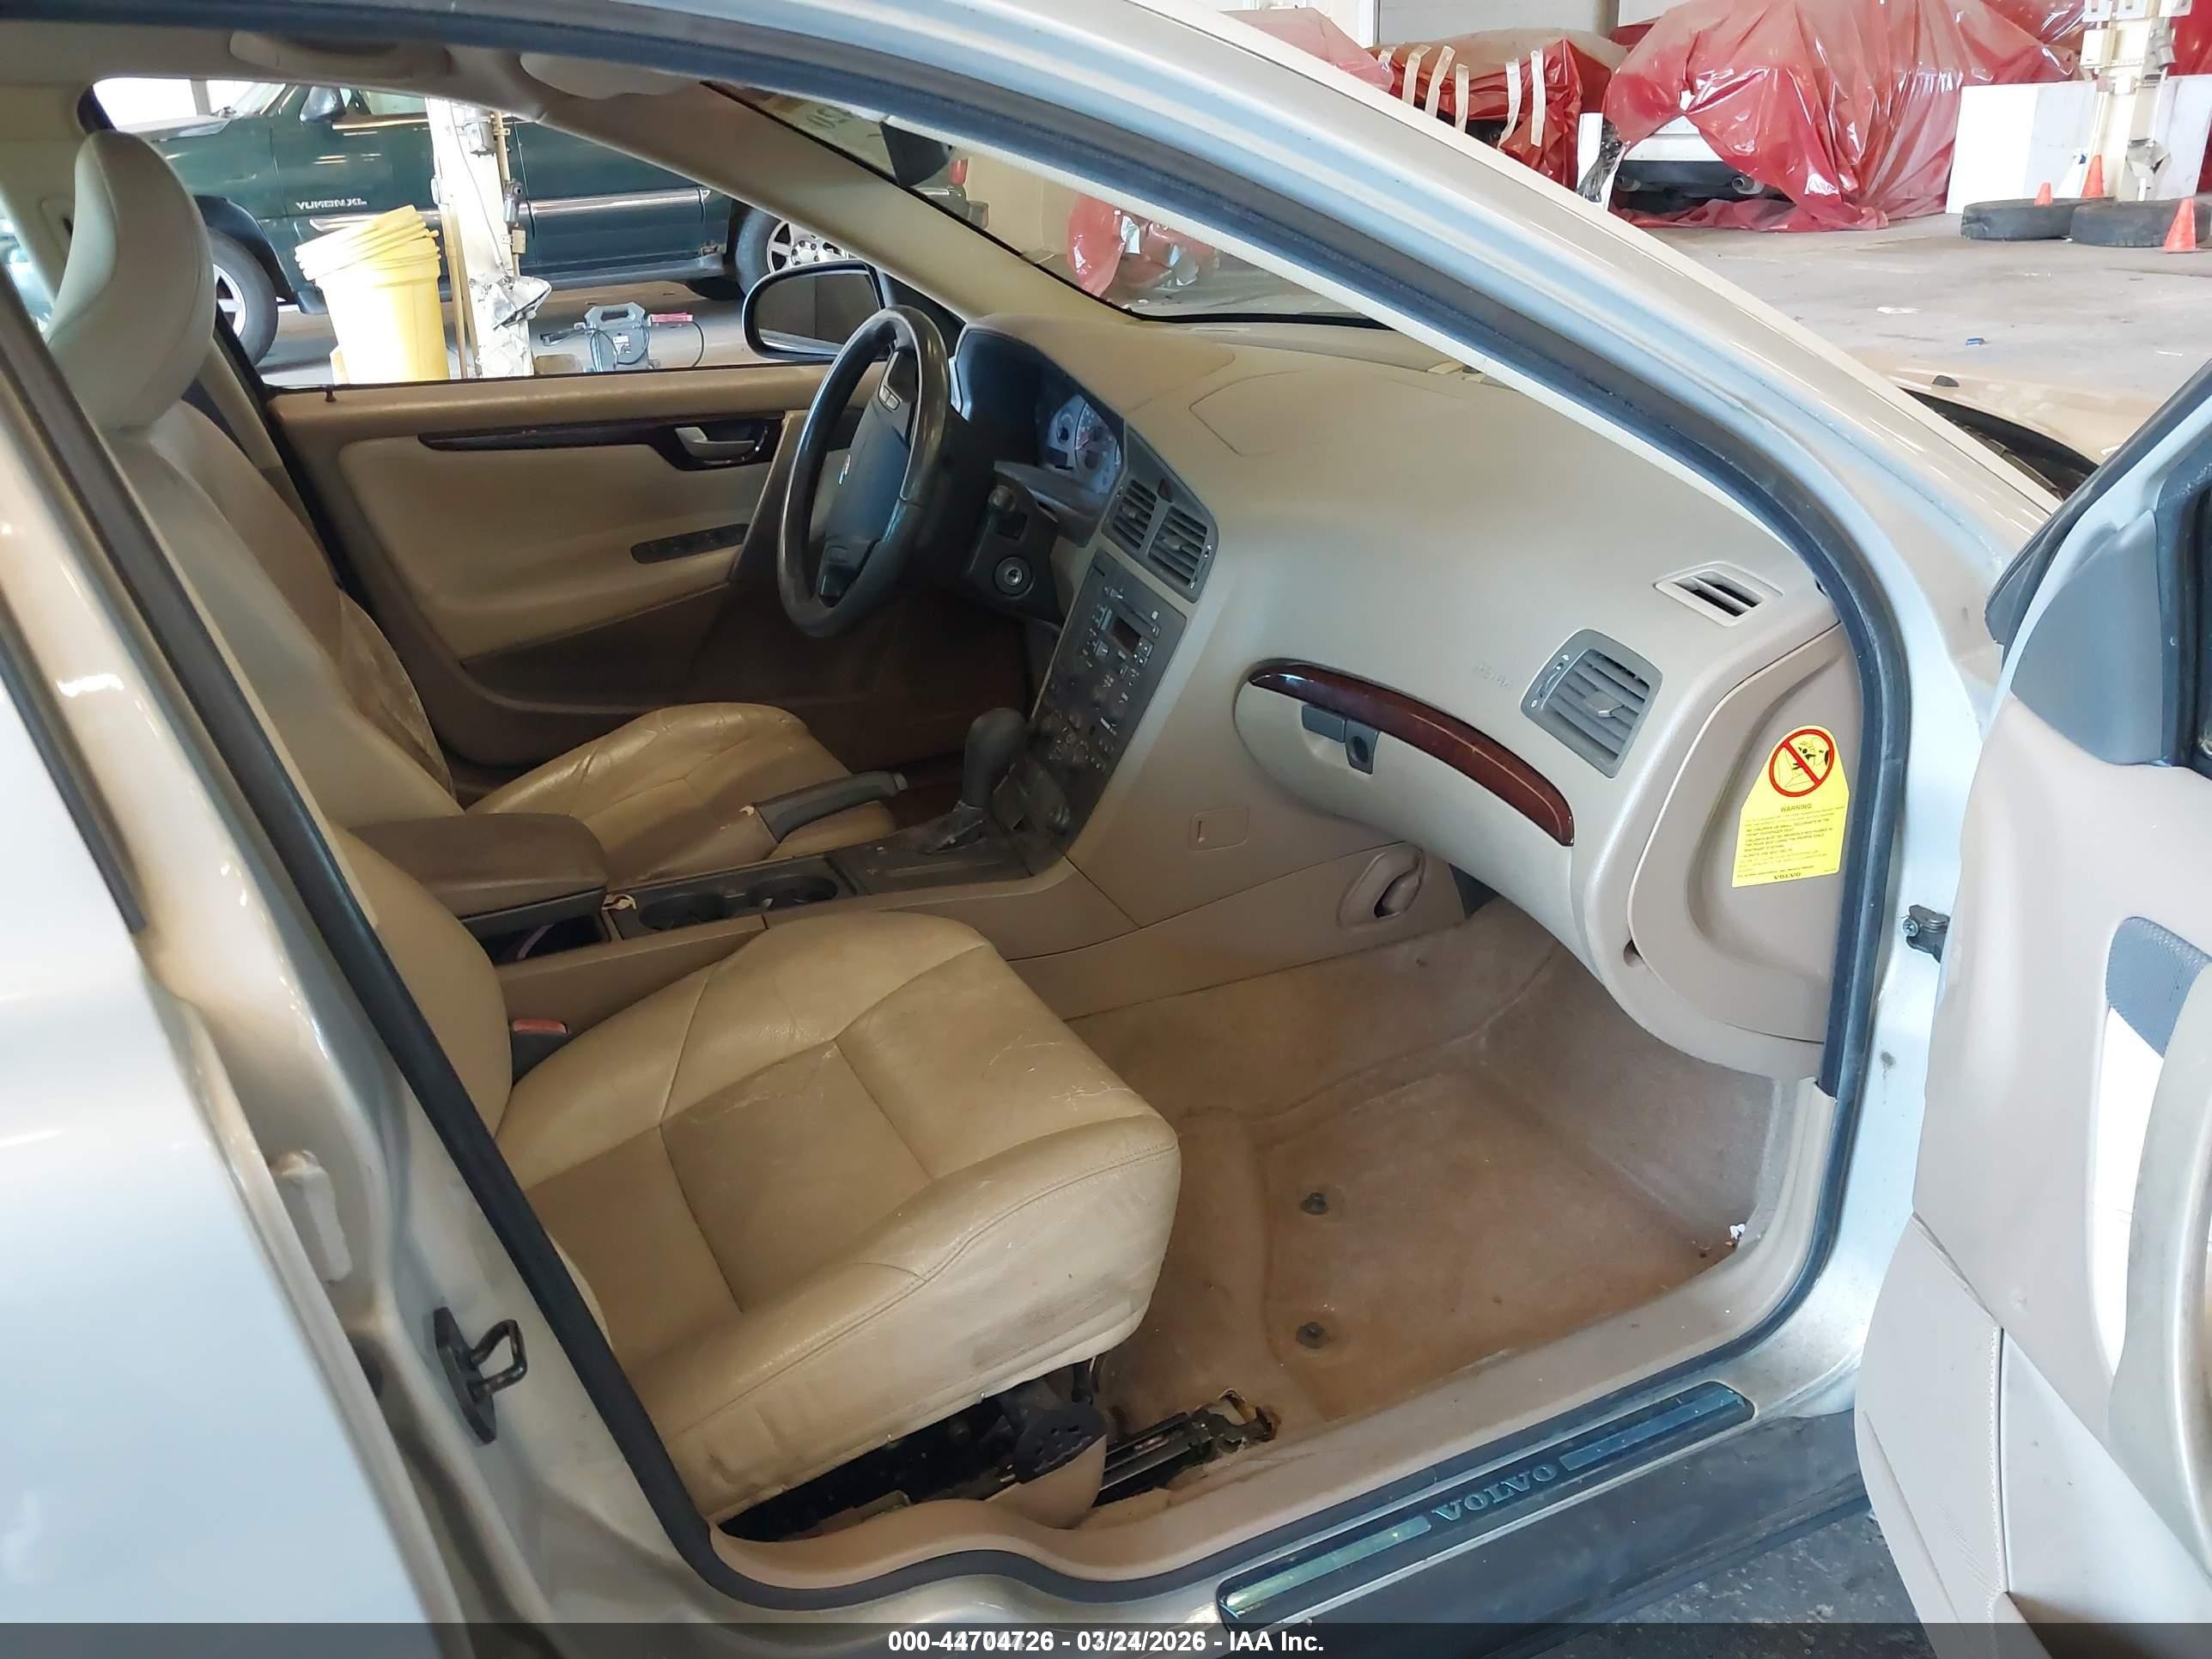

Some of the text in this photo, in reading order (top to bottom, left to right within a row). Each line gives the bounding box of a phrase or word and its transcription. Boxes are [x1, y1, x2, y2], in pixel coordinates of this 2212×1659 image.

[295, 198, 368, 210] YUKON XL
[1780, 803, 1812, 812] WARNING
[1773, 872, 1802, 880] VOLVO
[1431, 1463, 1558, 1521] VOLVO
